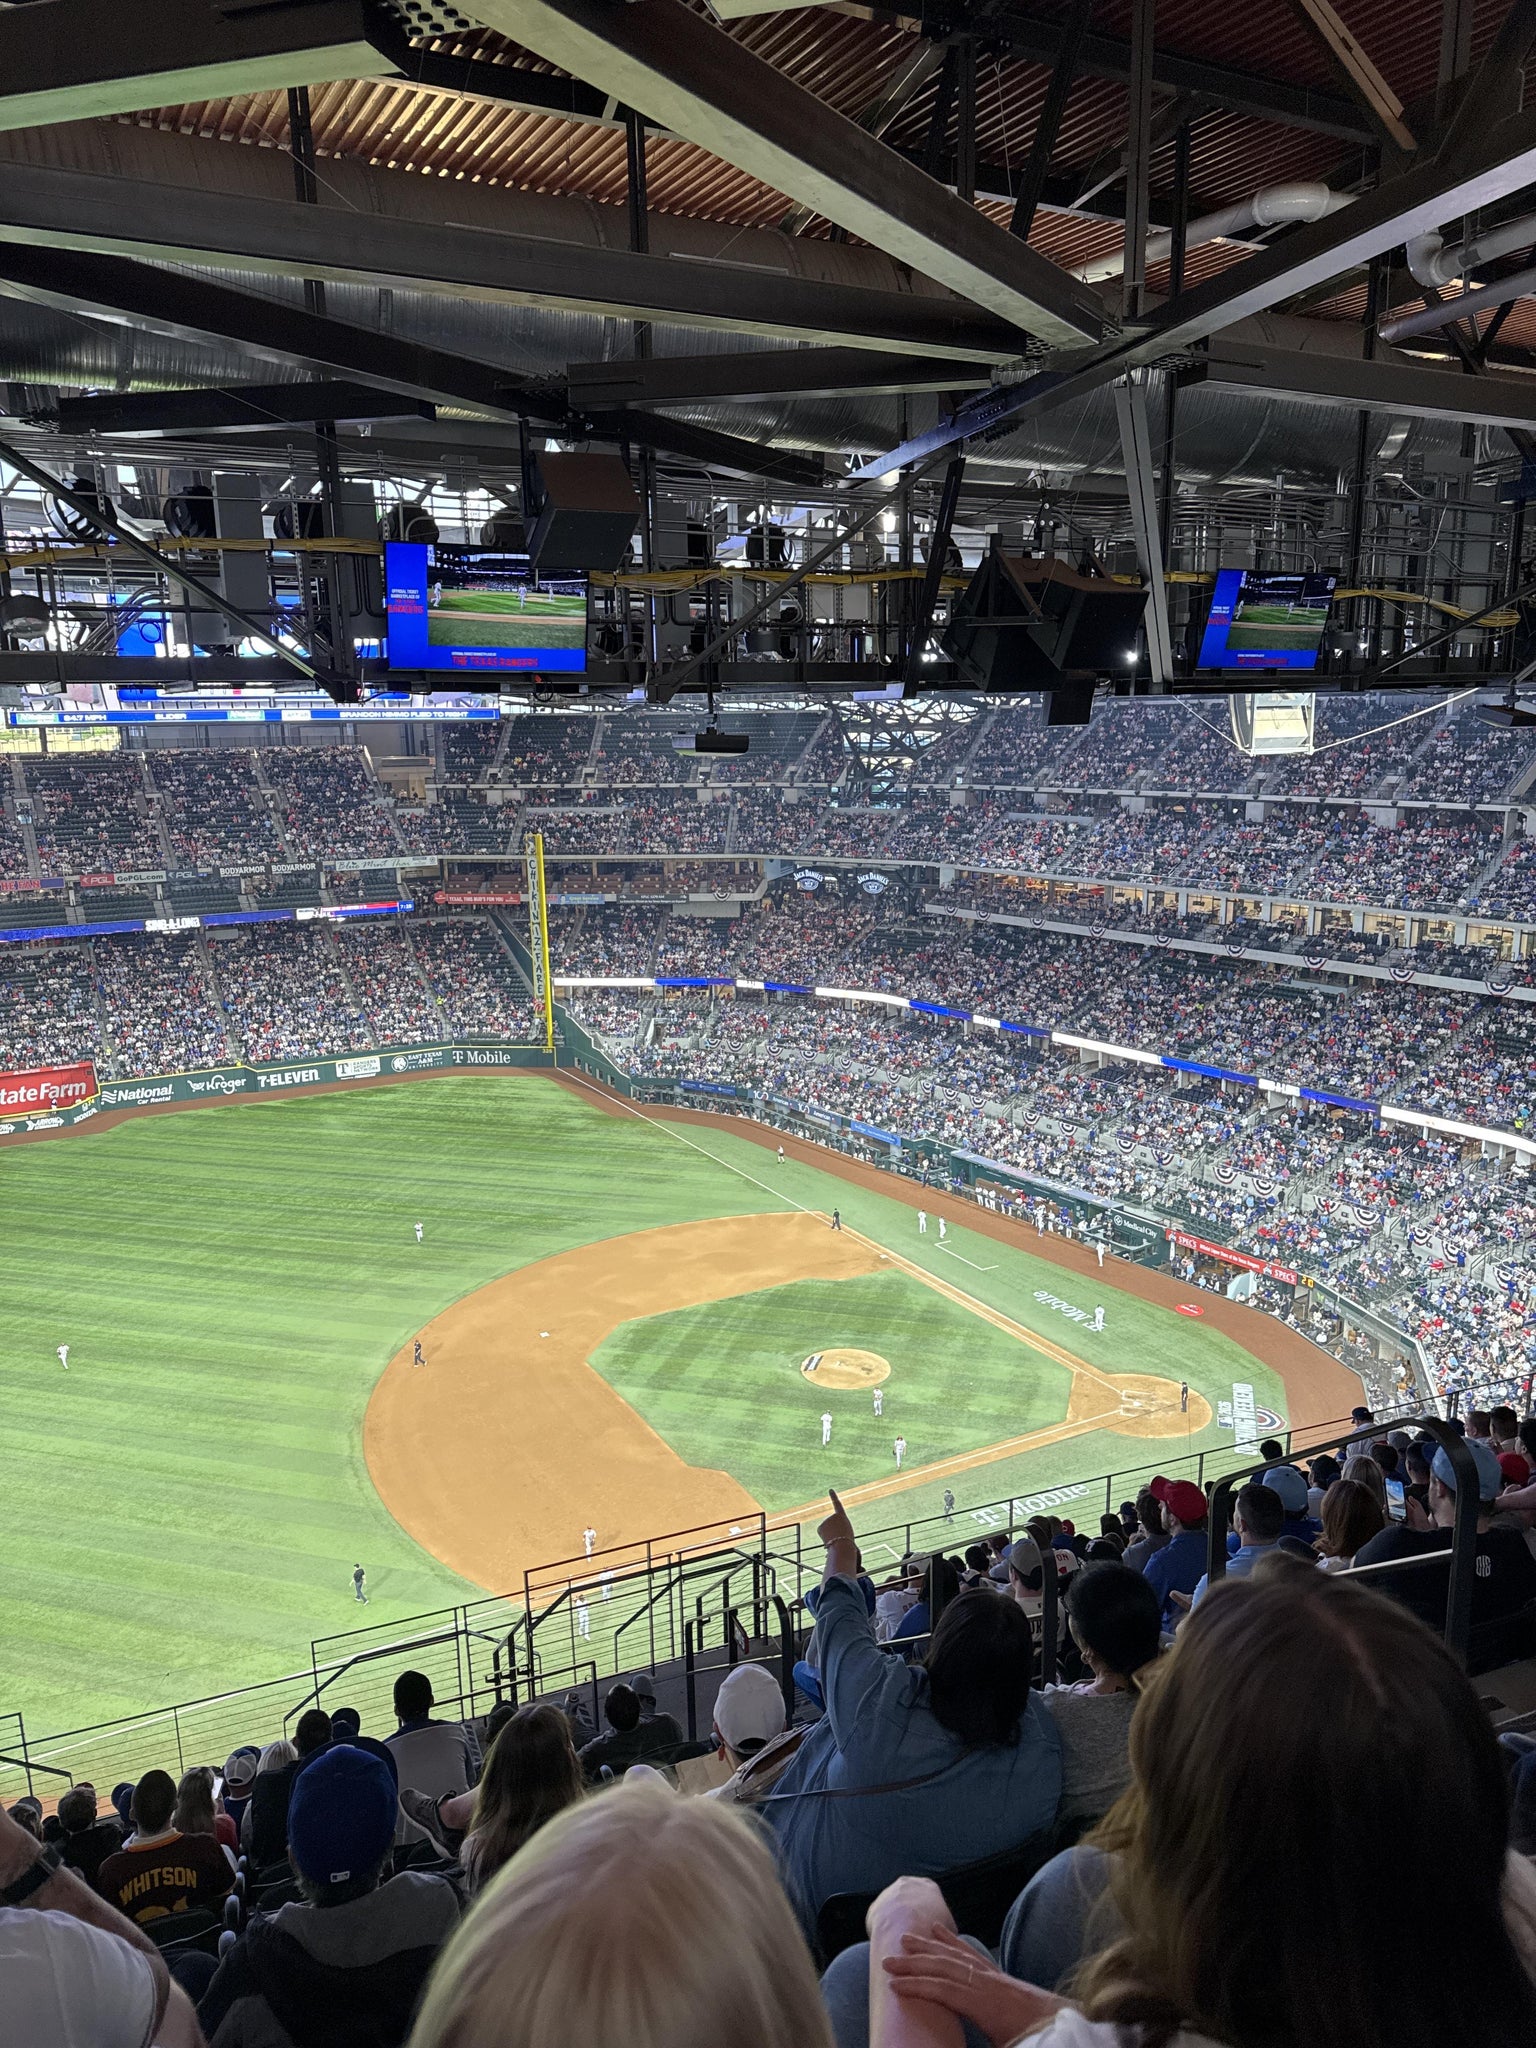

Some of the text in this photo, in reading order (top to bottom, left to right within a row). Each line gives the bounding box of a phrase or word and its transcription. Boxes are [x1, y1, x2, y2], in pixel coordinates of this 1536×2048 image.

[220, 866, 266, 876] BODYARMOR
[271, 862, 317, 873] BODYARMOR
[338, 861, 360, 870] Blue
[363, 859, 388, 868] Mint
[90, 876, 113, 884] PGL
[117, 874, 164, 882] GoPGL.com
[175, 871, 196, 879] PGL
[793, 869, 824, 882] JACK DANIEL'S
[857, 872, 889, 886] JACK DANIEL'S
[19, 880, 40, 889] FAN
[527, 858, 540, 922] CHIKIN
[533, 952, 544, 995] FARE
[418, 1057, 434, 1065] A&M
[466, 1050, 511, 1064] Mobile
[206, 1074, 247, 1095] Kroger
[0, 1081, 87, 1105] tate Farm
[151, 1095, 171, 1103] Rental
[772, 1096, 789, 1106] American
[73, 1107, 98, 1123] HONDA
[813, 1110, 831, 1120] American
[1123, 1219, 1157, 1239] Medical City
[1178, 1236, 1198, 1248] SPEC'S
[1274, 1269, 1296, 1282] SPEC'S
[1033, 1290, 1092, 1323] Mobile
[1232, 1383, 1259, 1456] OPENING WEEKEND
[1001, 1483, 1090, 1520] Mobile
[119, 1867, 196, 1905] WHITSON
